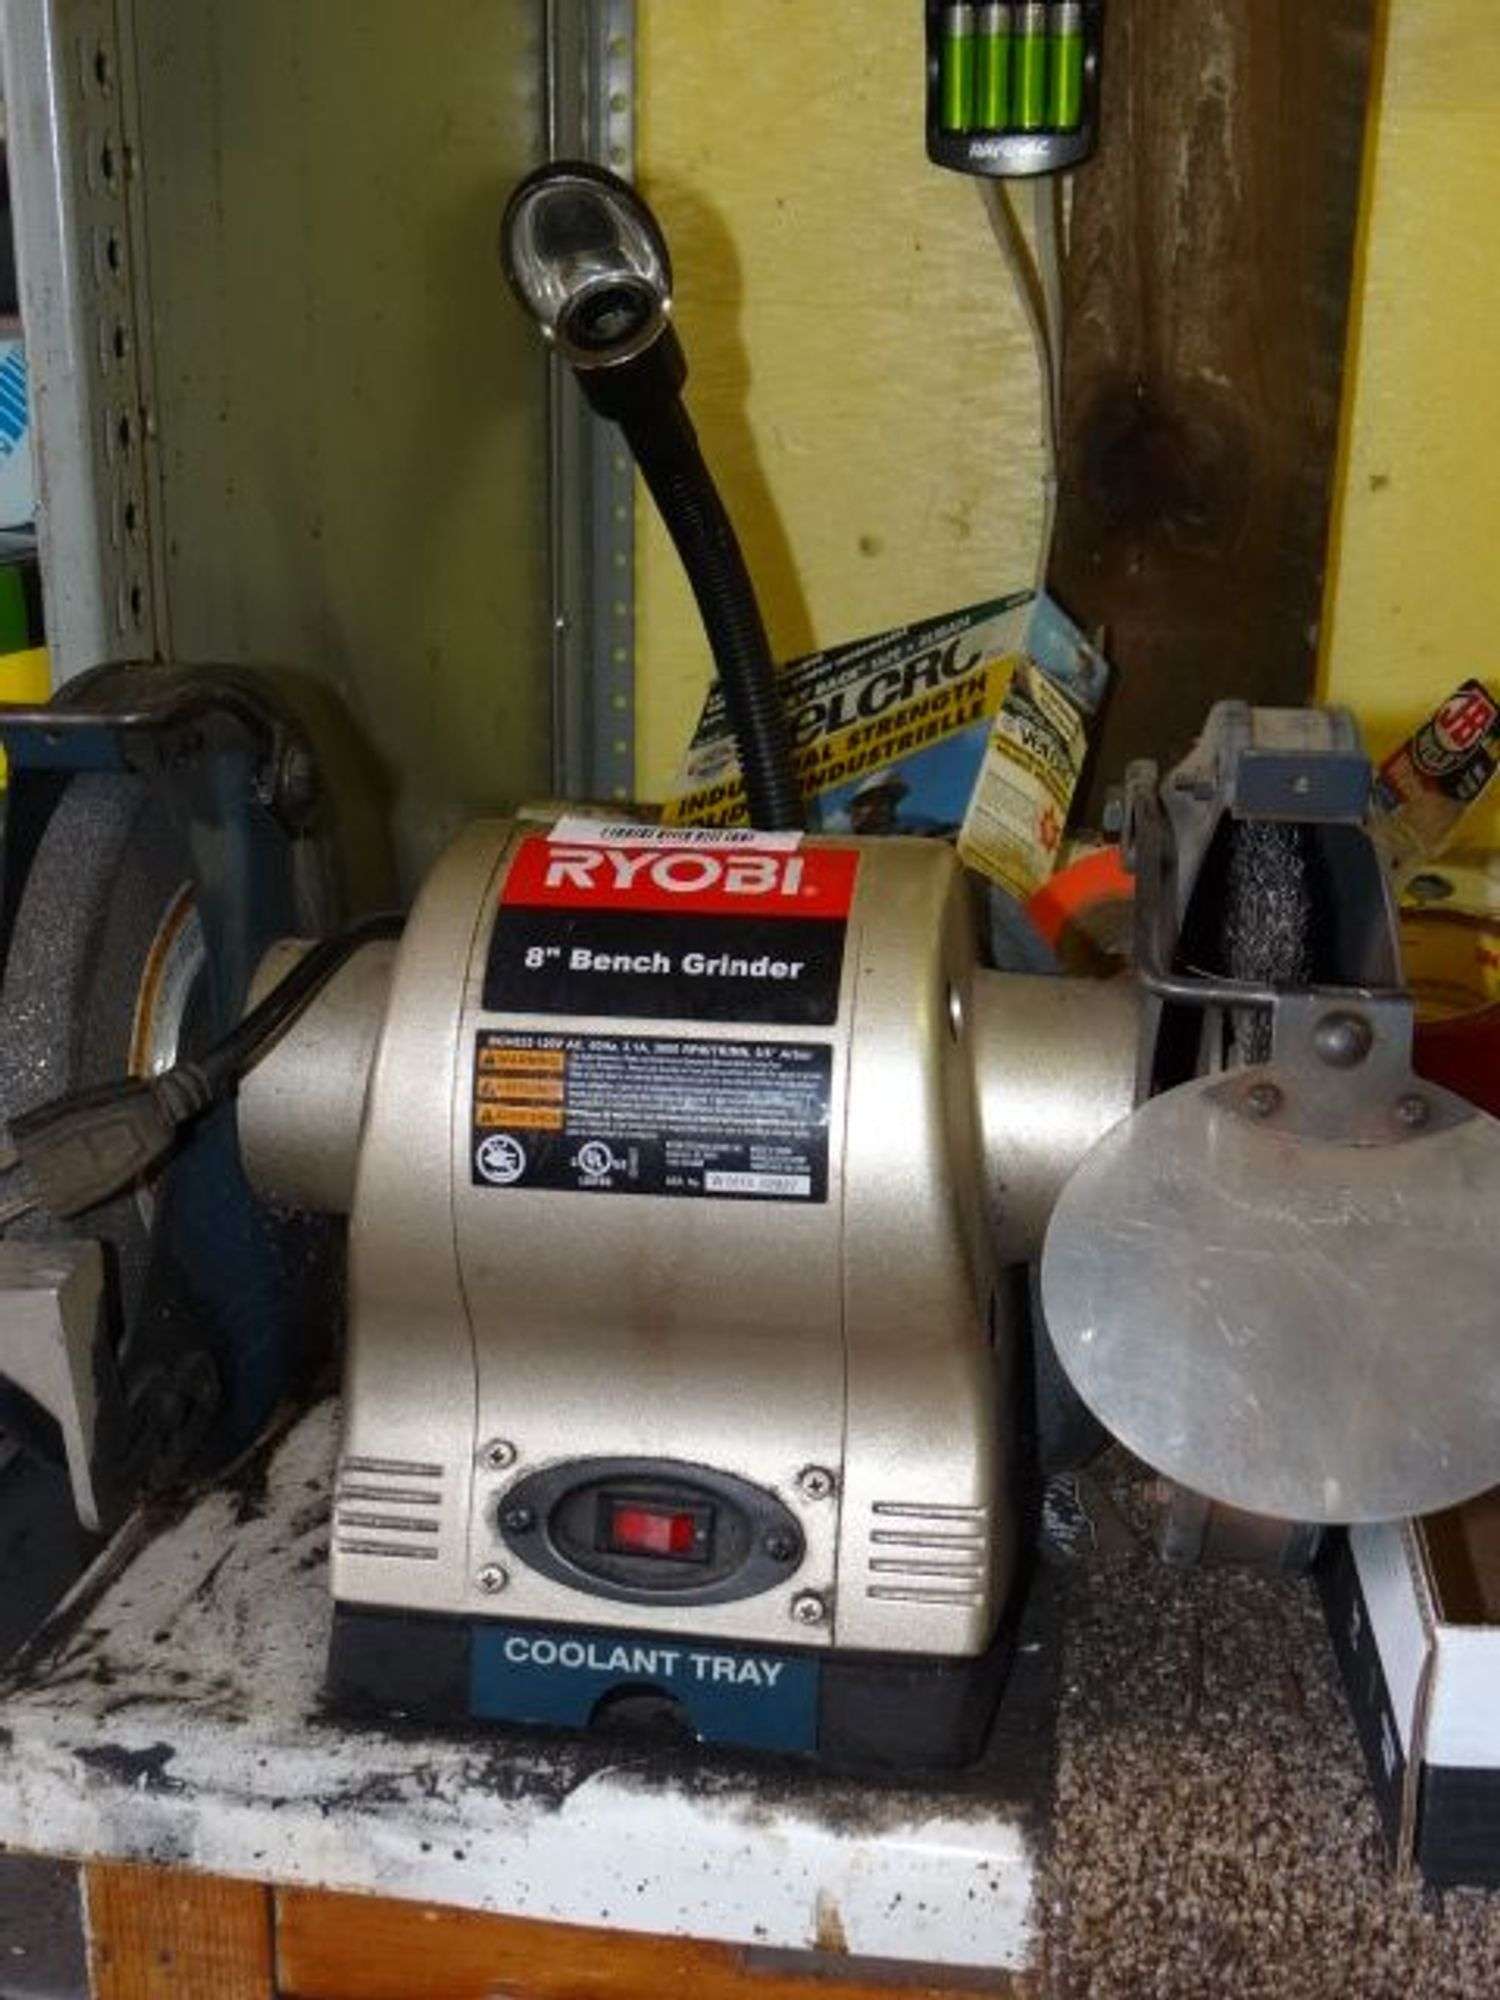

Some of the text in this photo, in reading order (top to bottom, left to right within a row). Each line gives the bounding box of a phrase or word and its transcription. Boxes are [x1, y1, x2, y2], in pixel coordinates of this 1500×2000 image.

[847, 670, 987, 744] STRENGTH
[803, 698, 986, 793] NDUSTRIELLE
[545, 847, 804, 896] RYOBI
[524, 946, 804, 980] 8" Bench Grinder
[504, 1636, 785, 1687] COOLANT TRAY
